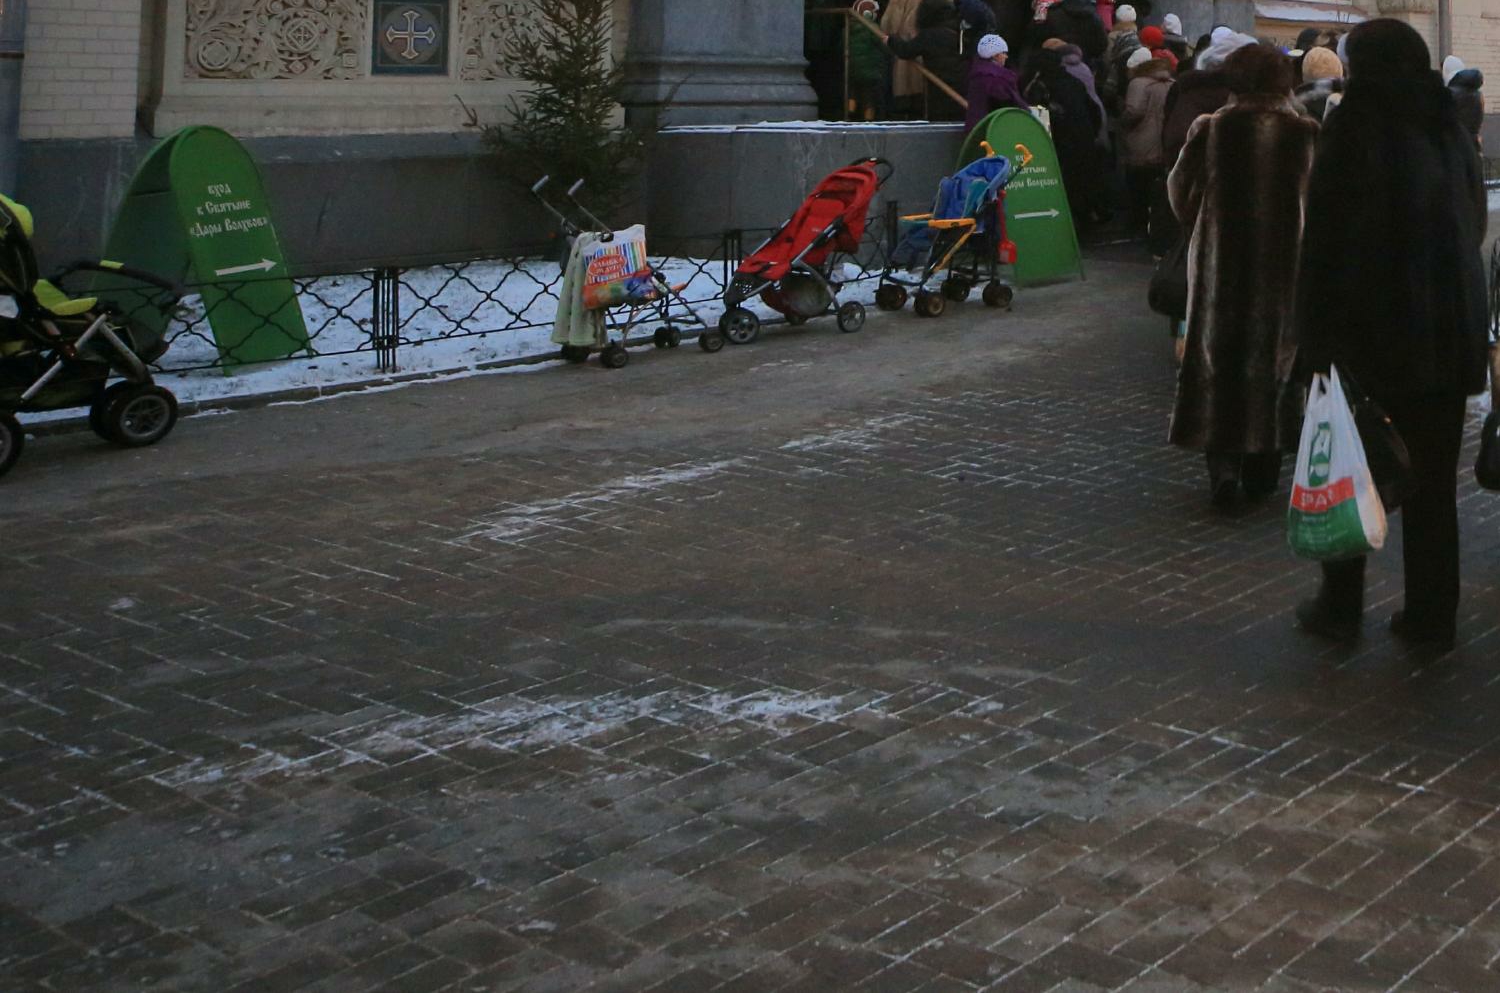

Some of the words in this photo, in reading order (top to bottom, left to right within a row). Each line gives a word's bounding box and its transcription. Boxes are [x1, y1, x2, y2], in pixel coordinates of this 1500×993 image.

[1012, 165, 1047, 175] Сятыне
[196, 206, 204, 215] к
[205, 200, 251, 214] Святыне
[190, 222, 222, 238] «Дары
